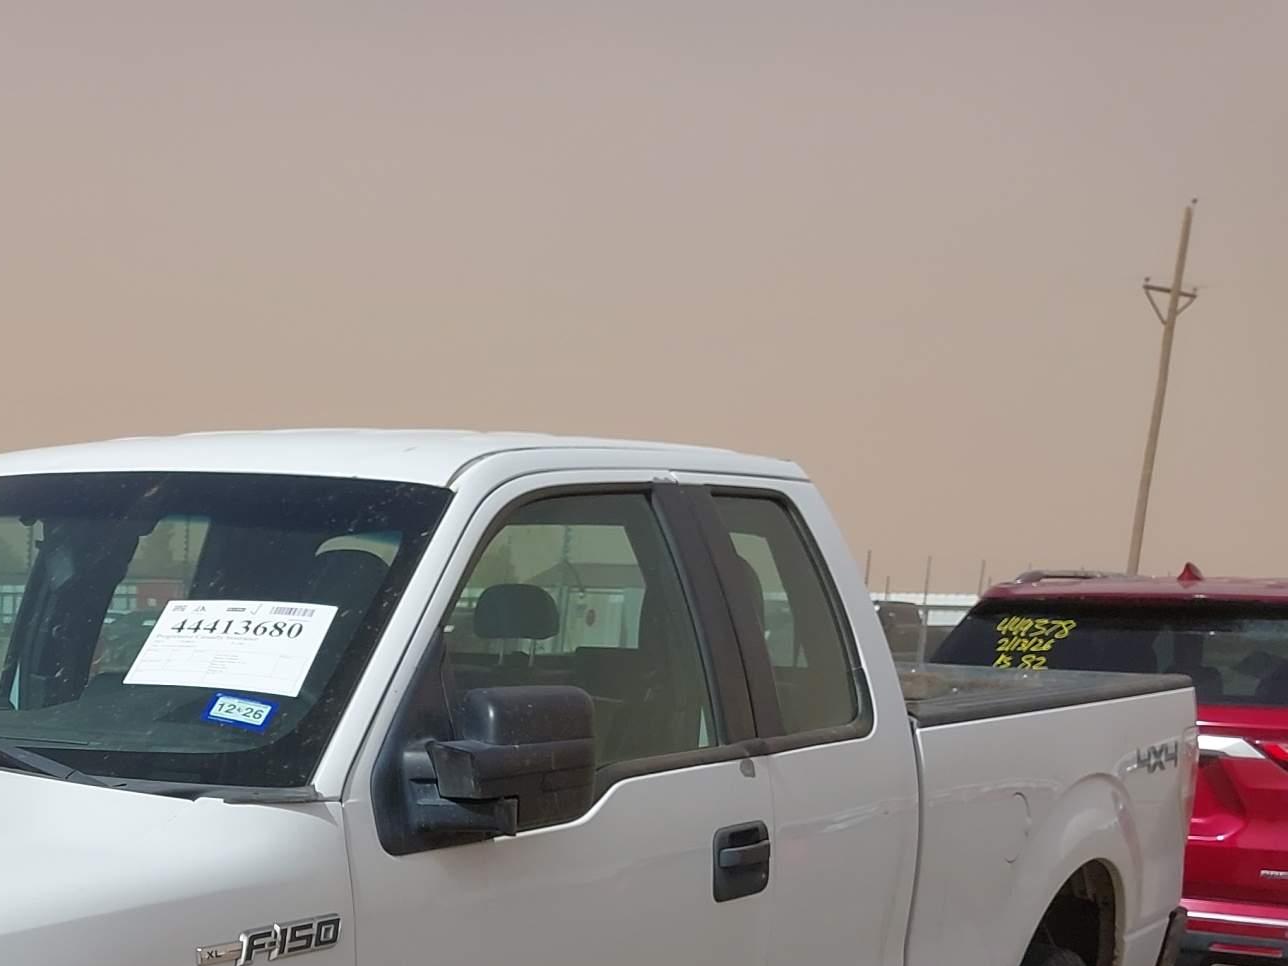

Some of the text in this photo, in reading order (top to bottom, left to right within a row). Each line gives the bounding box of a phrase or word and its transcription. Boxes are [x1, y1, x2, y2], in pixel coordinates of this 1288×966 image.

[170, 617, 304, 640] 44413680
[218, 702, 237, 714] 12
[242, 707, 265, 720] 26
[206, 949, 223, 960] XL
